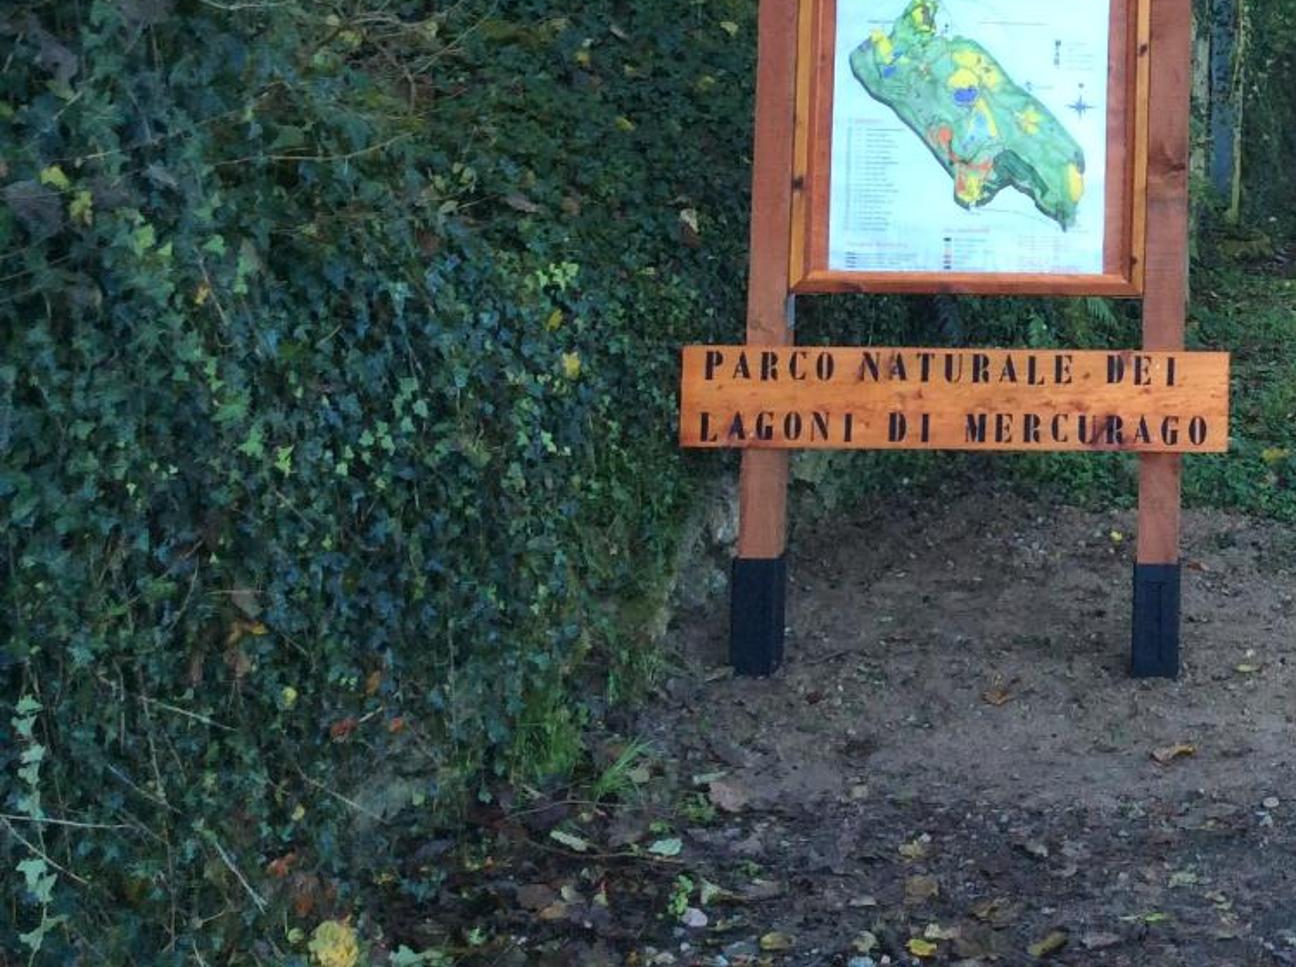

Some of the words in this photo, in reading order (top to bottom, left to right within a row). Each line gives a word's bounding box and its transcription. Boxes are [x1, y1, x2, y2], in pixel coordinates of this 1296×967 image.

[704, 350, 835, 381] PARCO
[859, 350, 1073, 386] NATURALE
[1106, 354, 1176, 386] DEI
[700, 411, 854, 443] LAGONI
[887, 412, 930, 443] DI
[965, 412, 1208, 446] MERCURAGO
